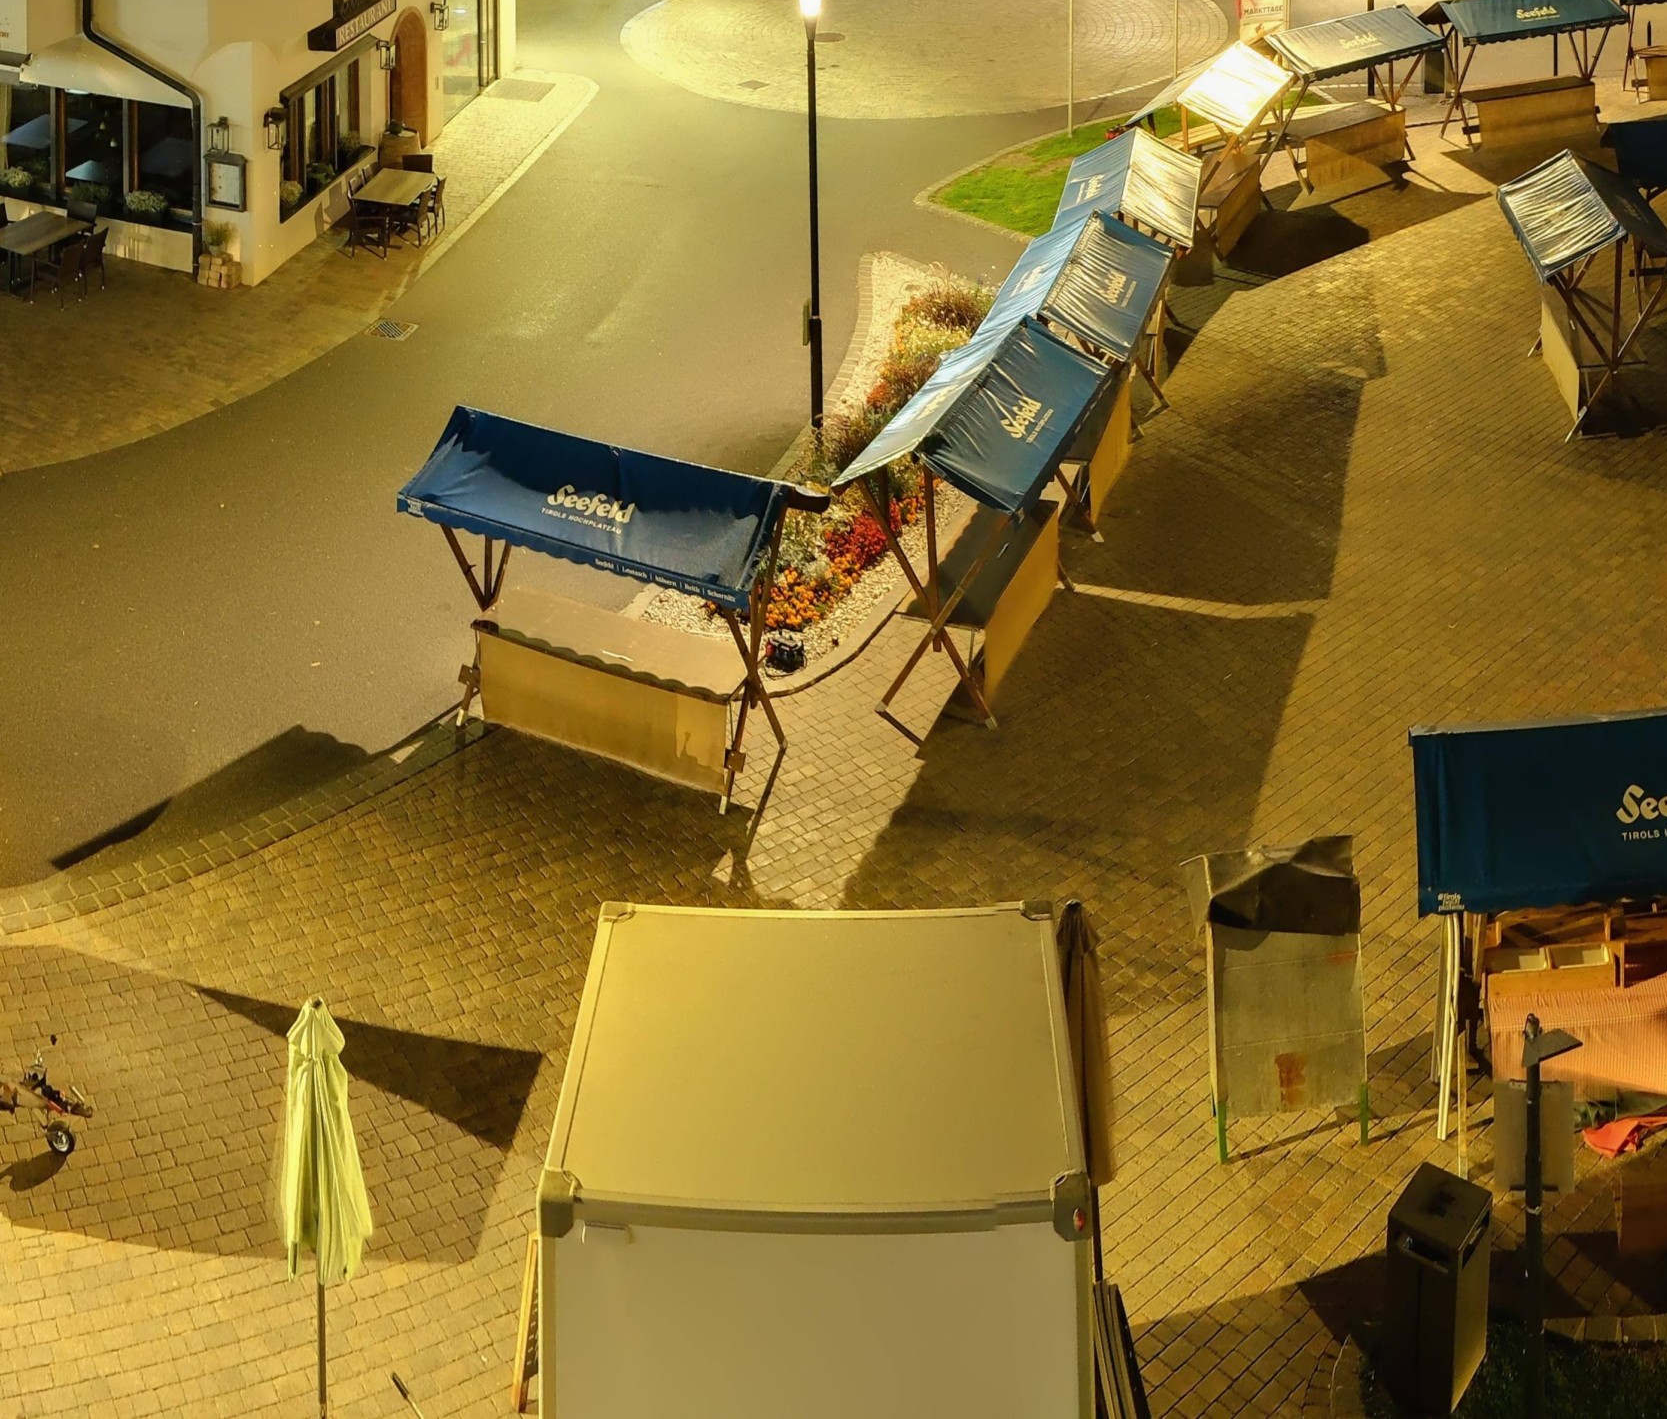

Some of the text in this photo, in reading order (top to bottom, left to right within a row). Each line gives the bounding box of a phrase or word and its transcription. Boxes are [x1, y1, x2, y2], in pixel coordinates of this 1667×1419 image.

[1244, 5, 1283, 14] MARKTTAGE
[1516, 5, 1557, 19] Seefeld
[1339, 32, 1378, 50] Seefeld
[546, 483, 637, 525] Seefeld
[541, 507, 622, 536] TIROLS HOCHPLATEAU
[1621, 831, 1661, 842] TIROLS
